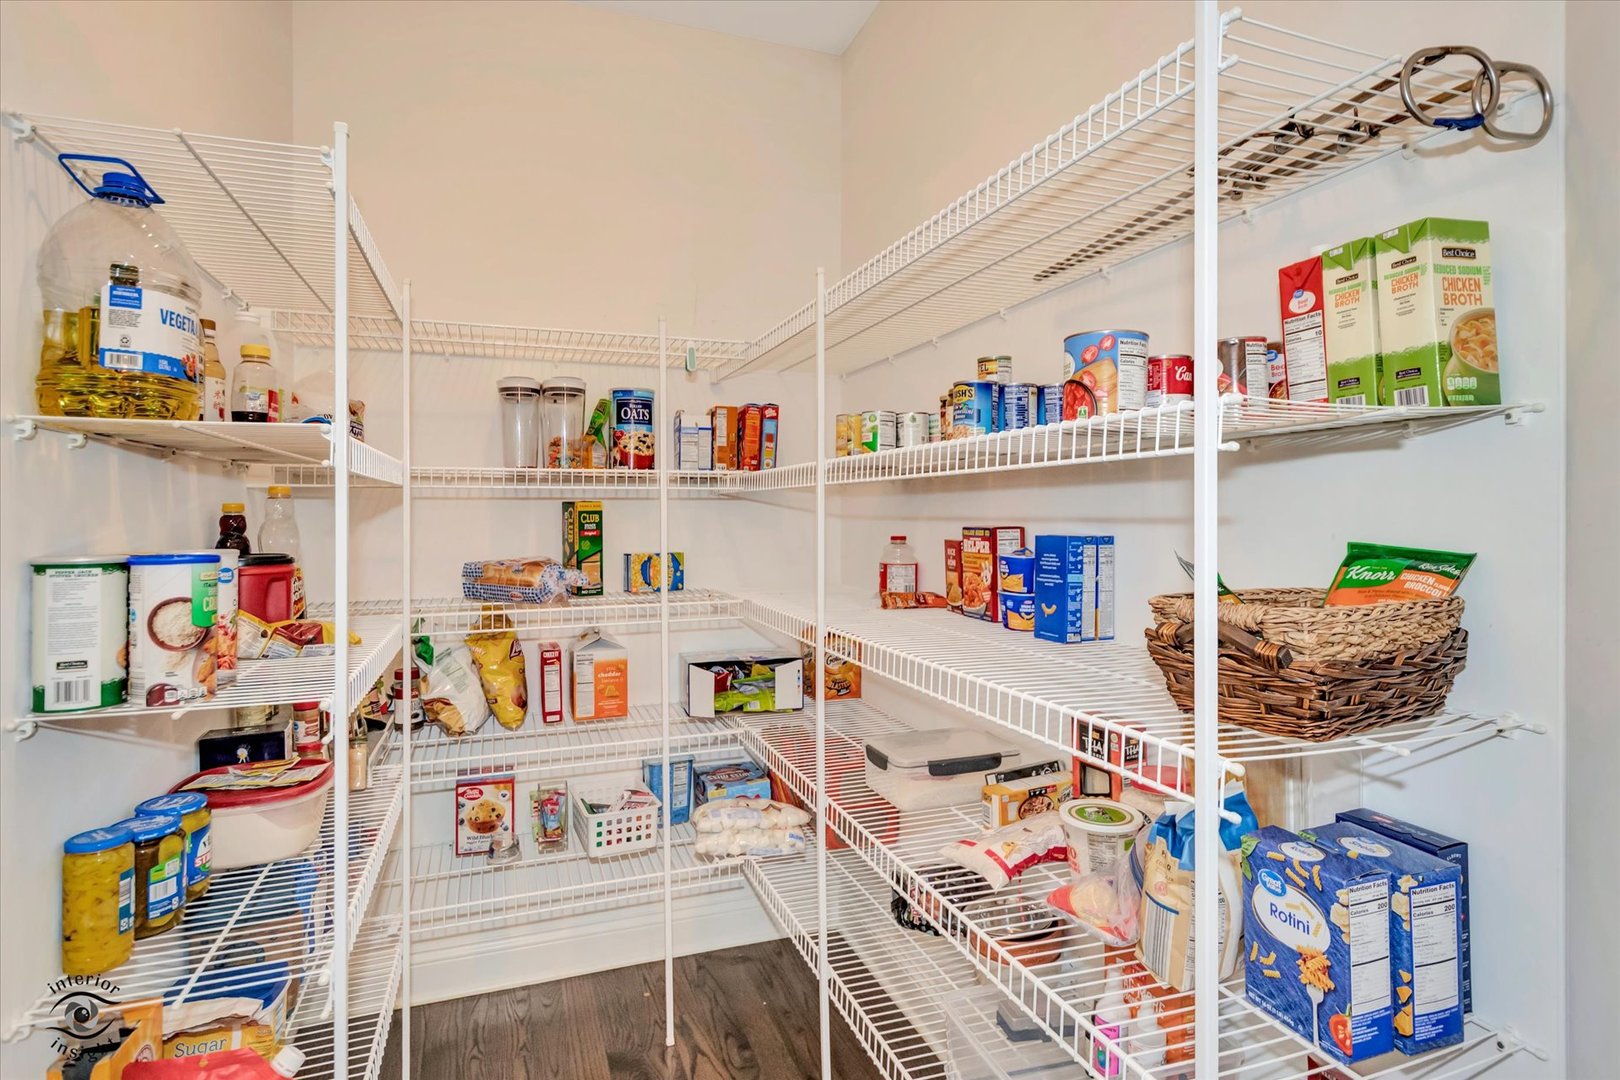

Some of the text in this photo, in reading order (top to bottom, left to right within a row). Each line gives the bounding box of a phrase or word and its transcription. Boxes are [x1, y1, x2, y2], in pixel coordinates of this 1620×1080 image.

[1443, 248, 1475, 257] Best Choice
[1391, 272, 1419, 287] CHICKEN
[1441, 276, 1482, 292] CHICKEN
[1392, 282, 1419, 294] BROTH
[1335, 289, 1360, 301] CHICKEN
[1443, 292, 1483, 306] BROTH
[1335, 297, 1360, 308] BROTH
[160, 308, 198, 336] VEGETA
[1284, 315, 1306, 325] Nutrition
[621, 407, 650, 420] OATS
[580, 513, 600, 523] CLUB
[963, 538, 990, 554] HELPER
[1346, 565, 1396, 581] Knorr
[1400, 572, 1435, 585] CHICKEN
[1349, 881, 1388, 893] Nutrition Facts
[1411, 883, 1455, 896] Nutrition Facts
[1350, 908, 1369, 916] Calories
[1377, 902, 1388, 910] 200
[1444, 903, 1456, 912] 200
[1270, 902, 1310, 935] Rotini
[1412, 910, 1434, 918] Calories
[174, 1037, 226, 1060] Sugar
